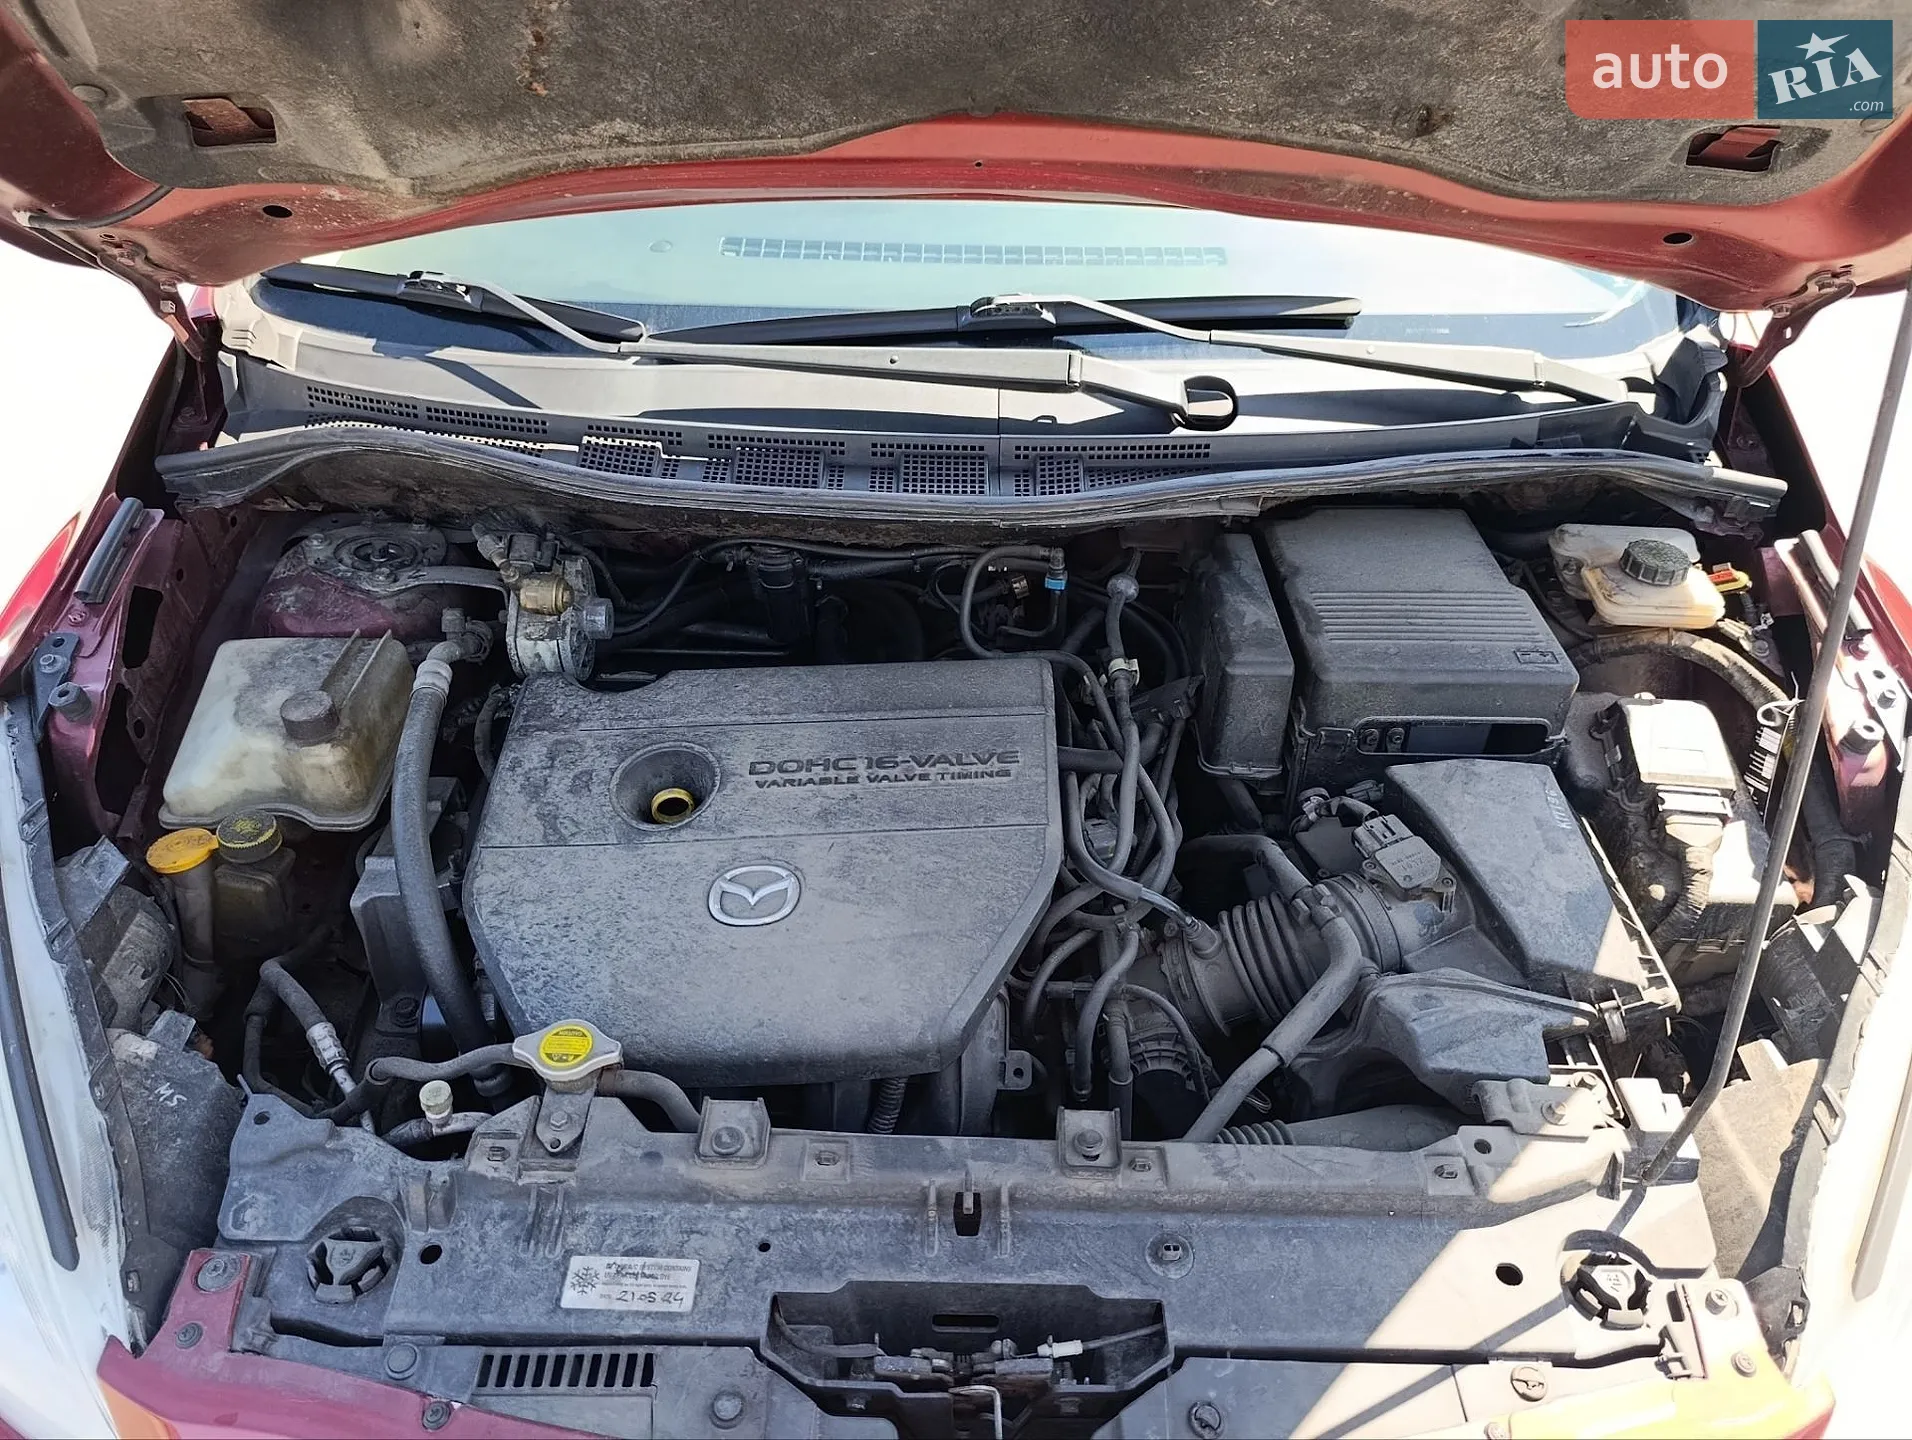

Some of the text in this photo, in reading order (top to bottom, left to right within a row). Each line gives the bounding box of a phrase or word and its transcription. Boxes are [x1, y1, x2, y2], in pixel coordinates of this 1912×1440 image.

[749, 751, 1020, 776] DOHC 16-VALVE
[755, 769, 1012, 789] VARIABLE VALVE TIMING
